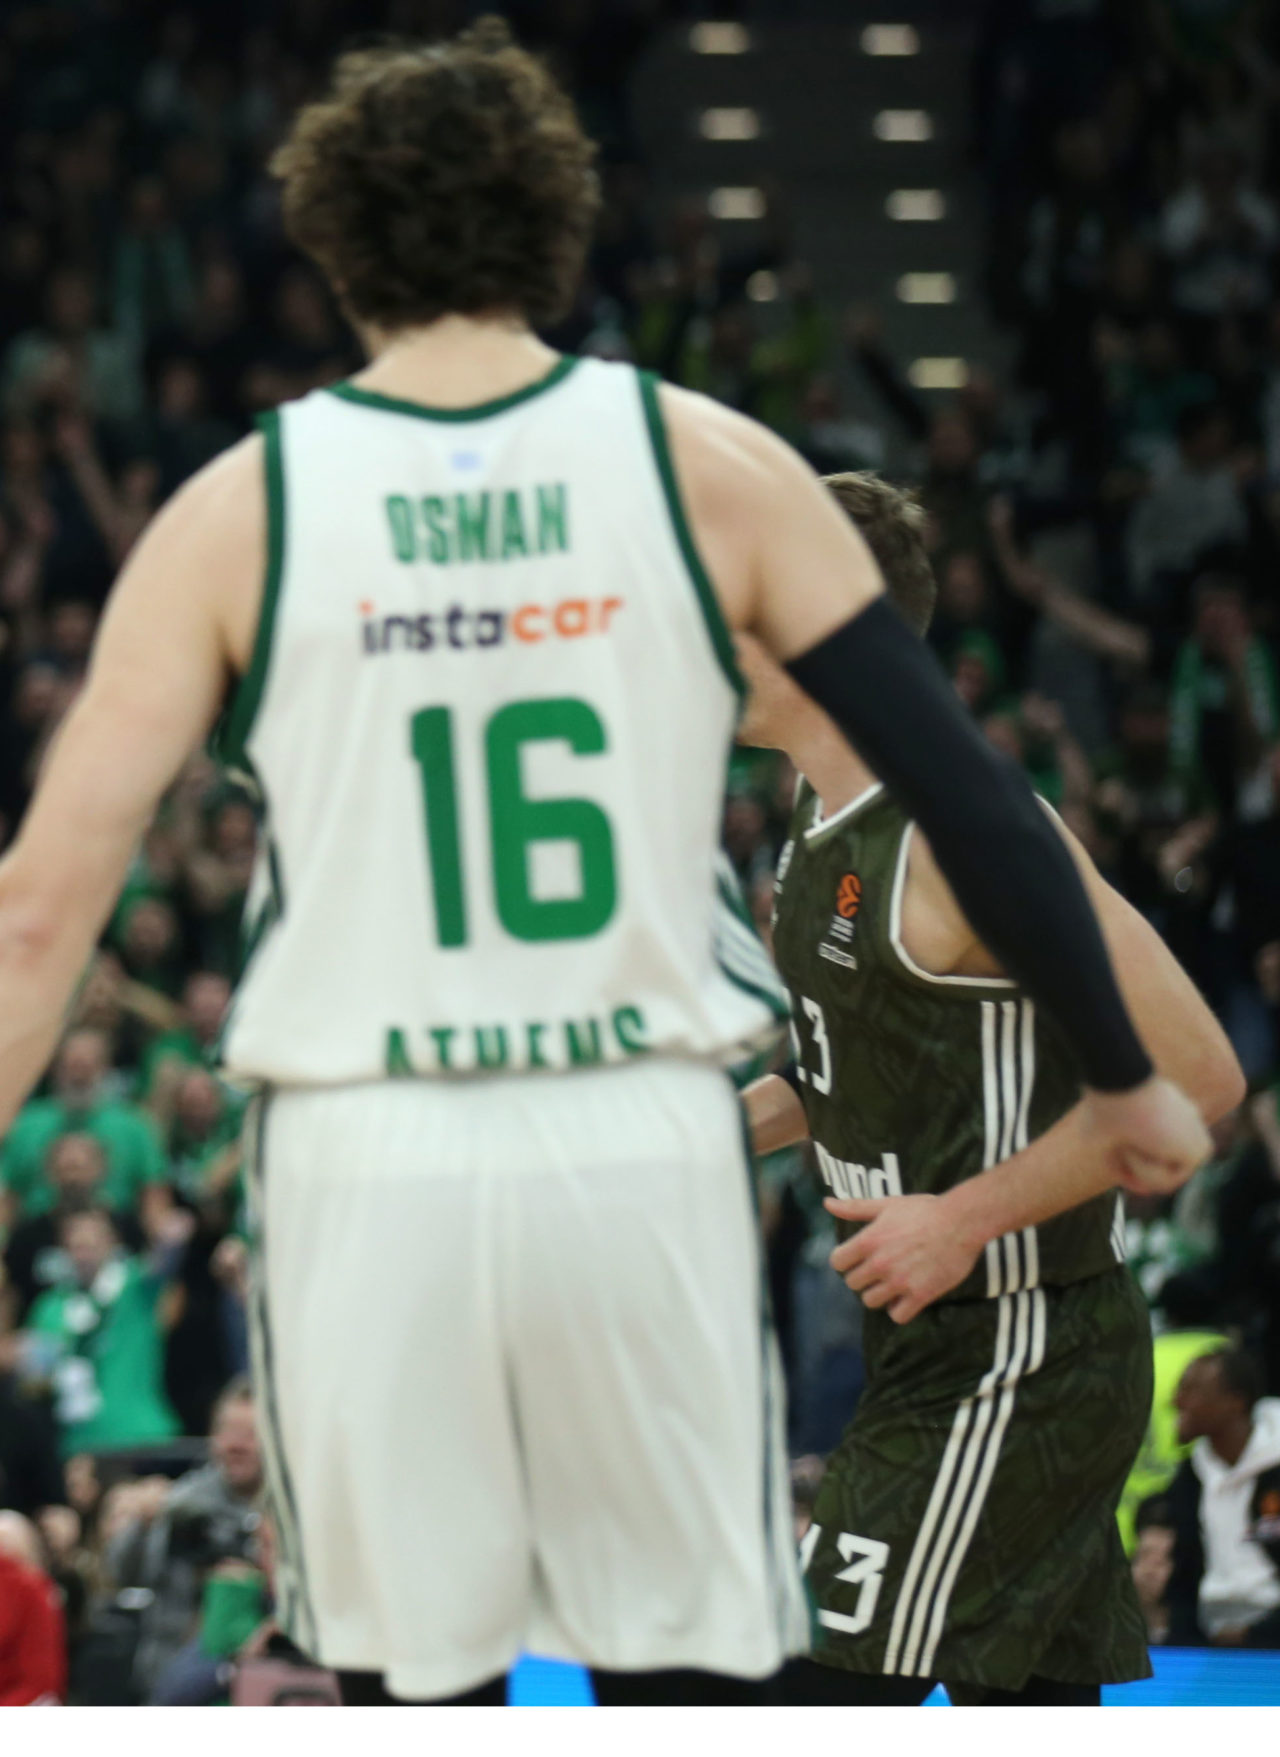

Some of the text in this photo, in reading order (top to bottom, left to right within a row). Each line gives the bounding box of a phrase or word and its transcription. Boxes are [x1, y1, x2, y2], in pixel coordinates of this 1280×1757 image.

[384, 482, 568, 565] OSMAN
[358, 597, 623, 655] instacar
[408, 695, 618, 949] 16
